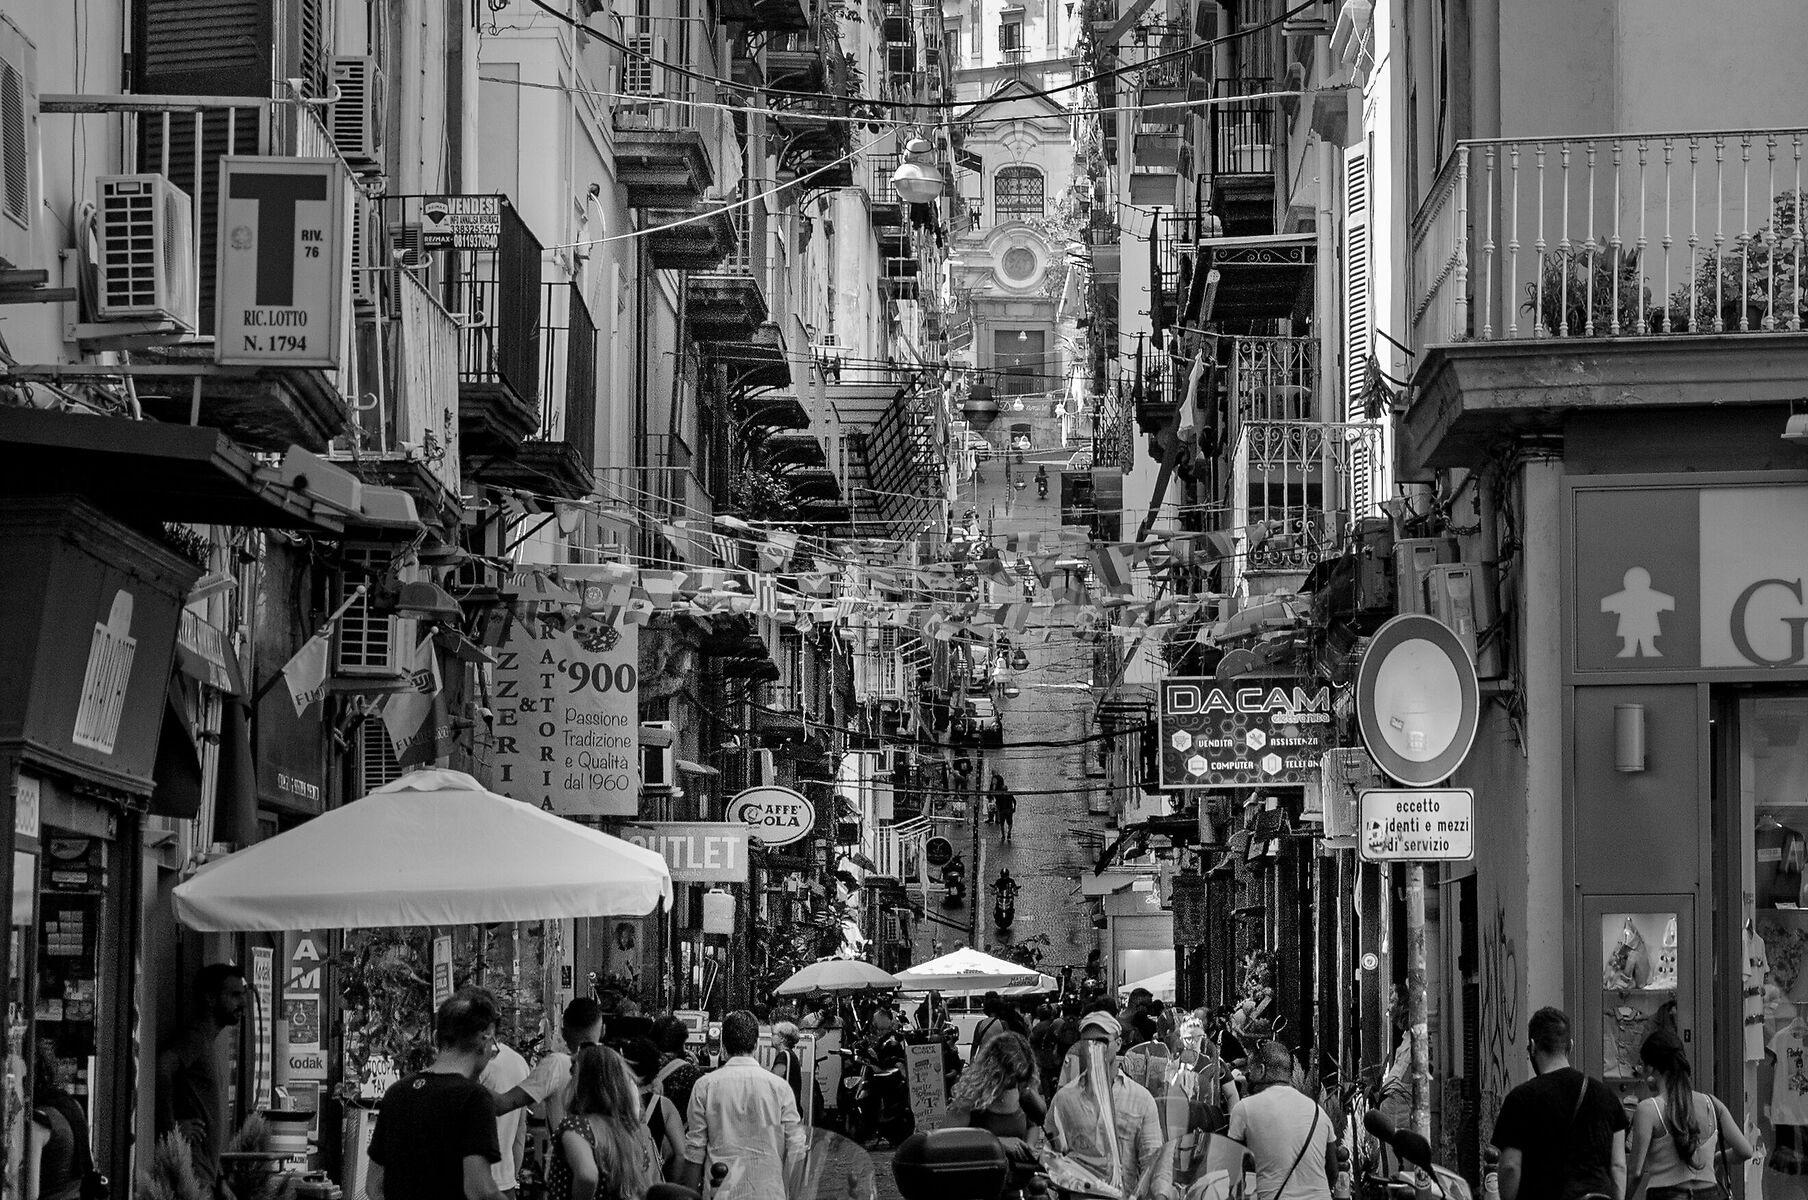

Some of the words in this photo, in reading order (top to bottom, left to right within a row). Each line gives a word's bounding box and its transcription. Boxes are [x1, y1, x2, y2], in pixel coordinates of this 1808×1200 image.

[447, 197, 498, 215] VENDESI
[301, 229, 323, 243] RIV.
[304, 246, 319, 258] 76
[243, 335, 263, 351] N.
[269, 335, 307, 351] 1794
[1167, 685, 1330, 714] DACAM
[565, 707, 628, 727] Passione
[563, 729, 632, 748] Tradizione
[1198, 739, 1233, 748] VENDITA
[1270, 737, 1318, 746] ASSISTENZA
[565, 756, 573, 768] e
[578, 751, 628, 771] Qualità
[1211, 761, 1254, 770] COMPUTER
[564, 773, 584, 791] dal
[588, 773, 629, 792] 1960
[1396, 798, 1440, 813] eccetto
[1425, 821, 1431, 832] e
[1437, 816, 1469, 832] mezzi
[1387, 837, 1398, 852] di
[1404, 836, 1450, 851] servizio
[289, 1056, 323, 1069] Kodak
